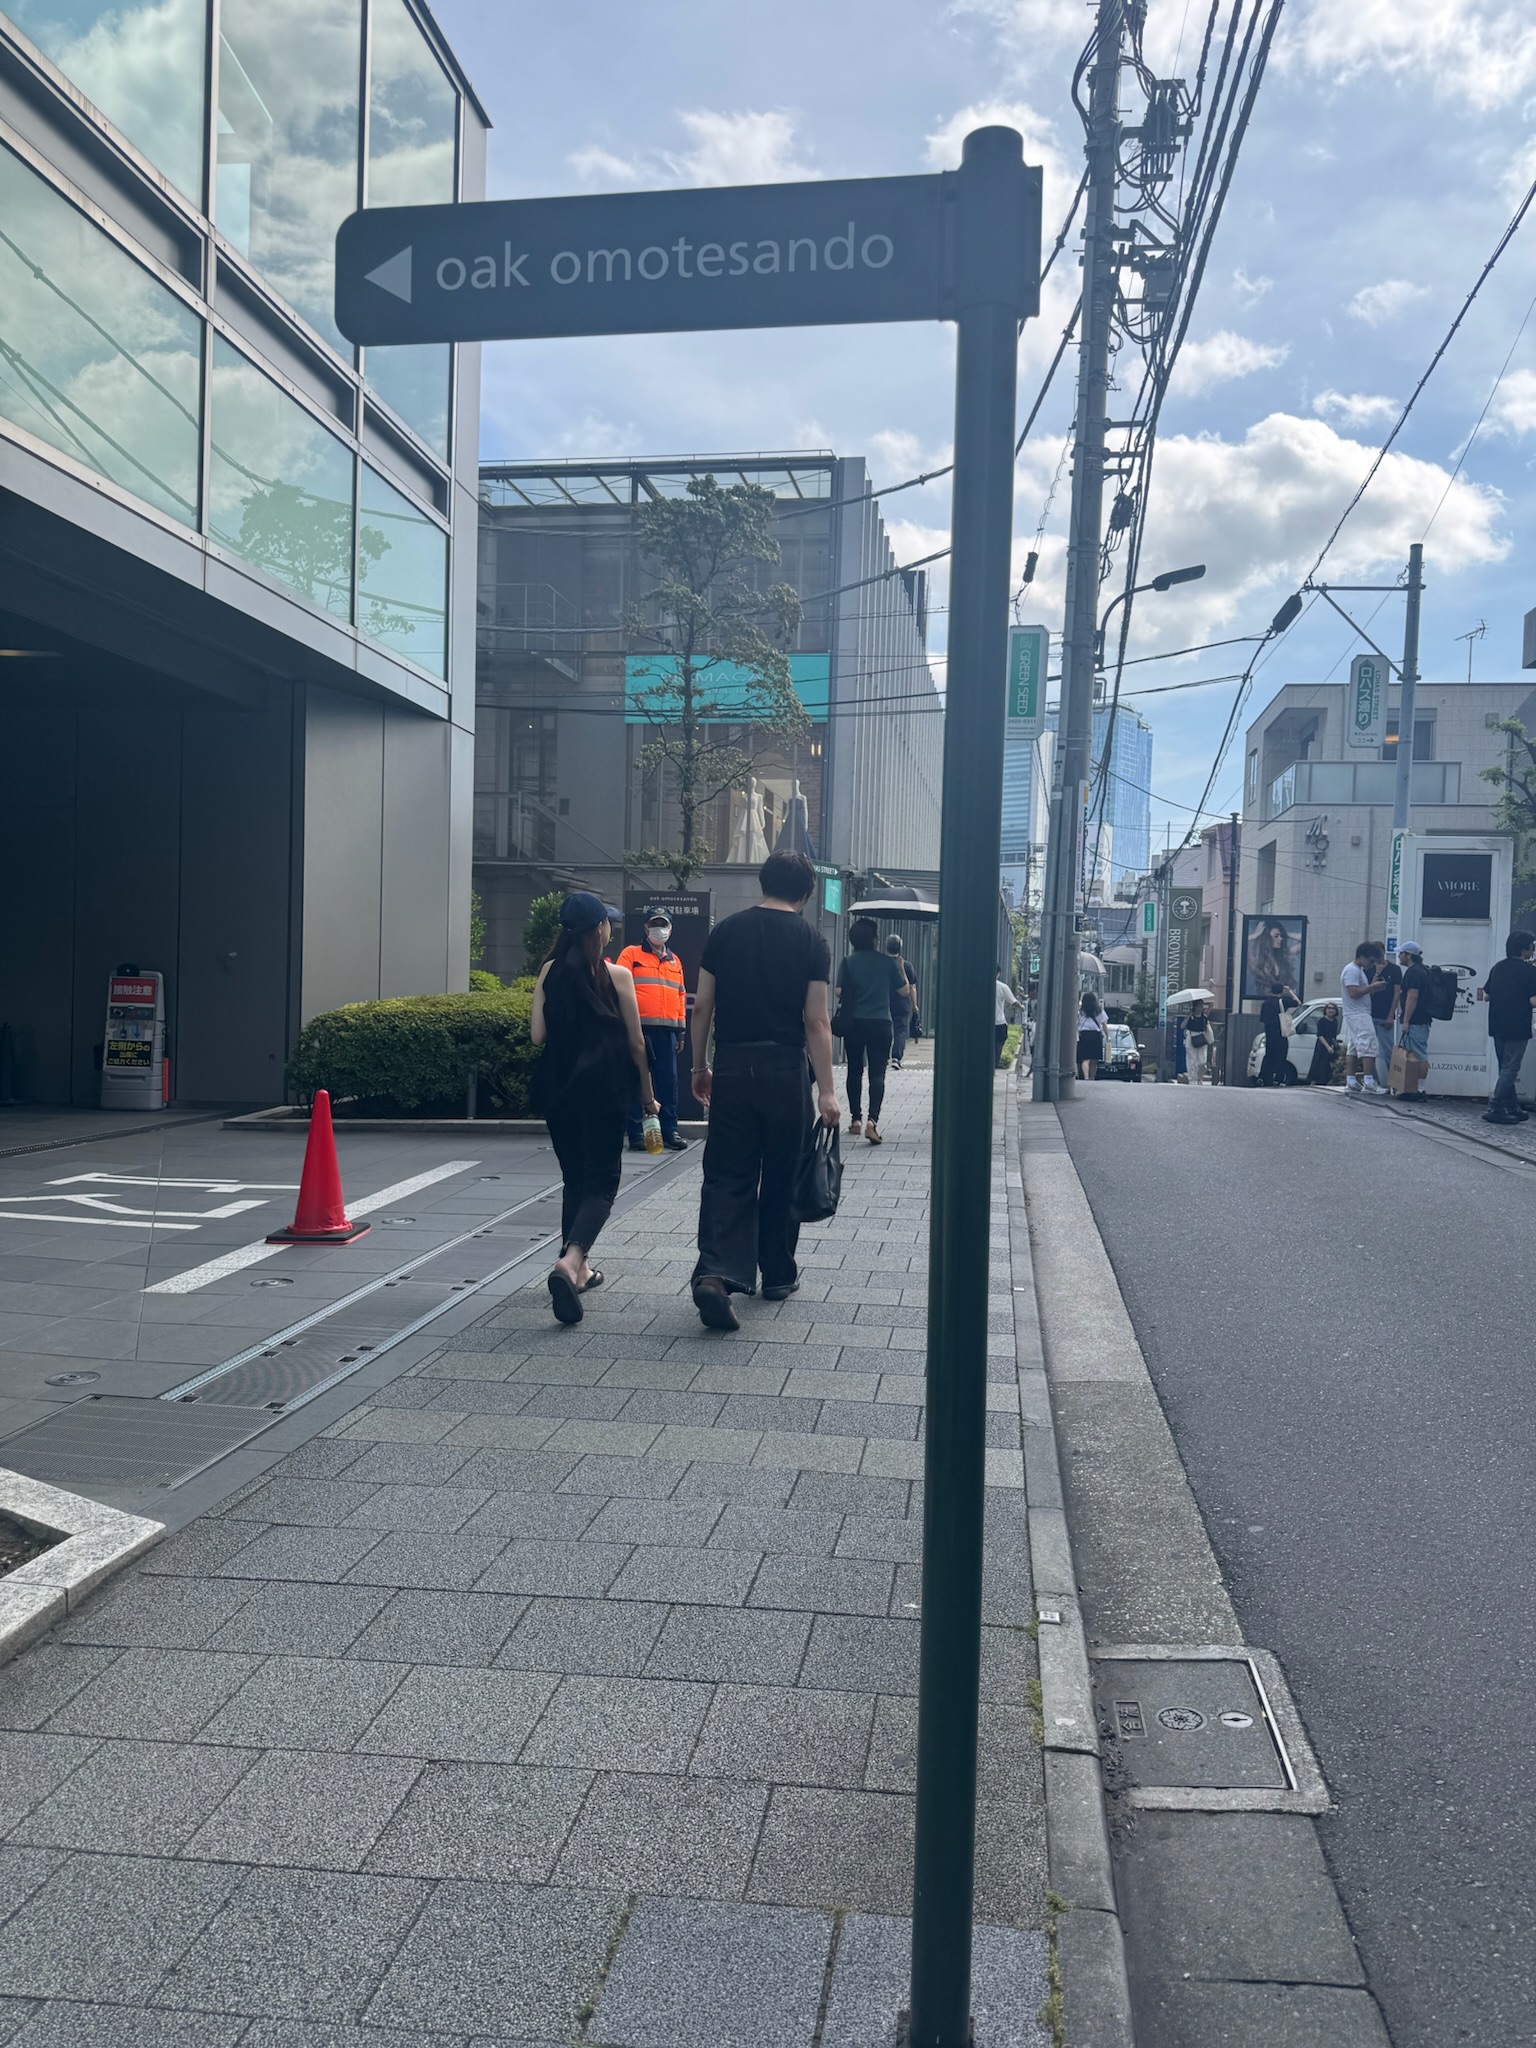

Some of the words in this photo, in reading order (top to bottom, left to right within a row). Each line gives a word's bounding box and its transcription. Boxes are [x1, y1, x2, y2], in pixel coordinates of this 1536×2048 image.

[435, 239, 531, 292] oak
[549, 220, 895, 285] omotesando
[1019, 649, 1031, 686] GREEN
[1017, 687, 1029, 715] SEED
[1358, 666, 1372, 725] ロハス通り
[1437, 880, 1480, 892] AMORE
[1168, 928, 1181, 969] BROWN
[112, 984, 152, 996] 接触注意
[1464, 1064, 1487, 1072] 表参道
